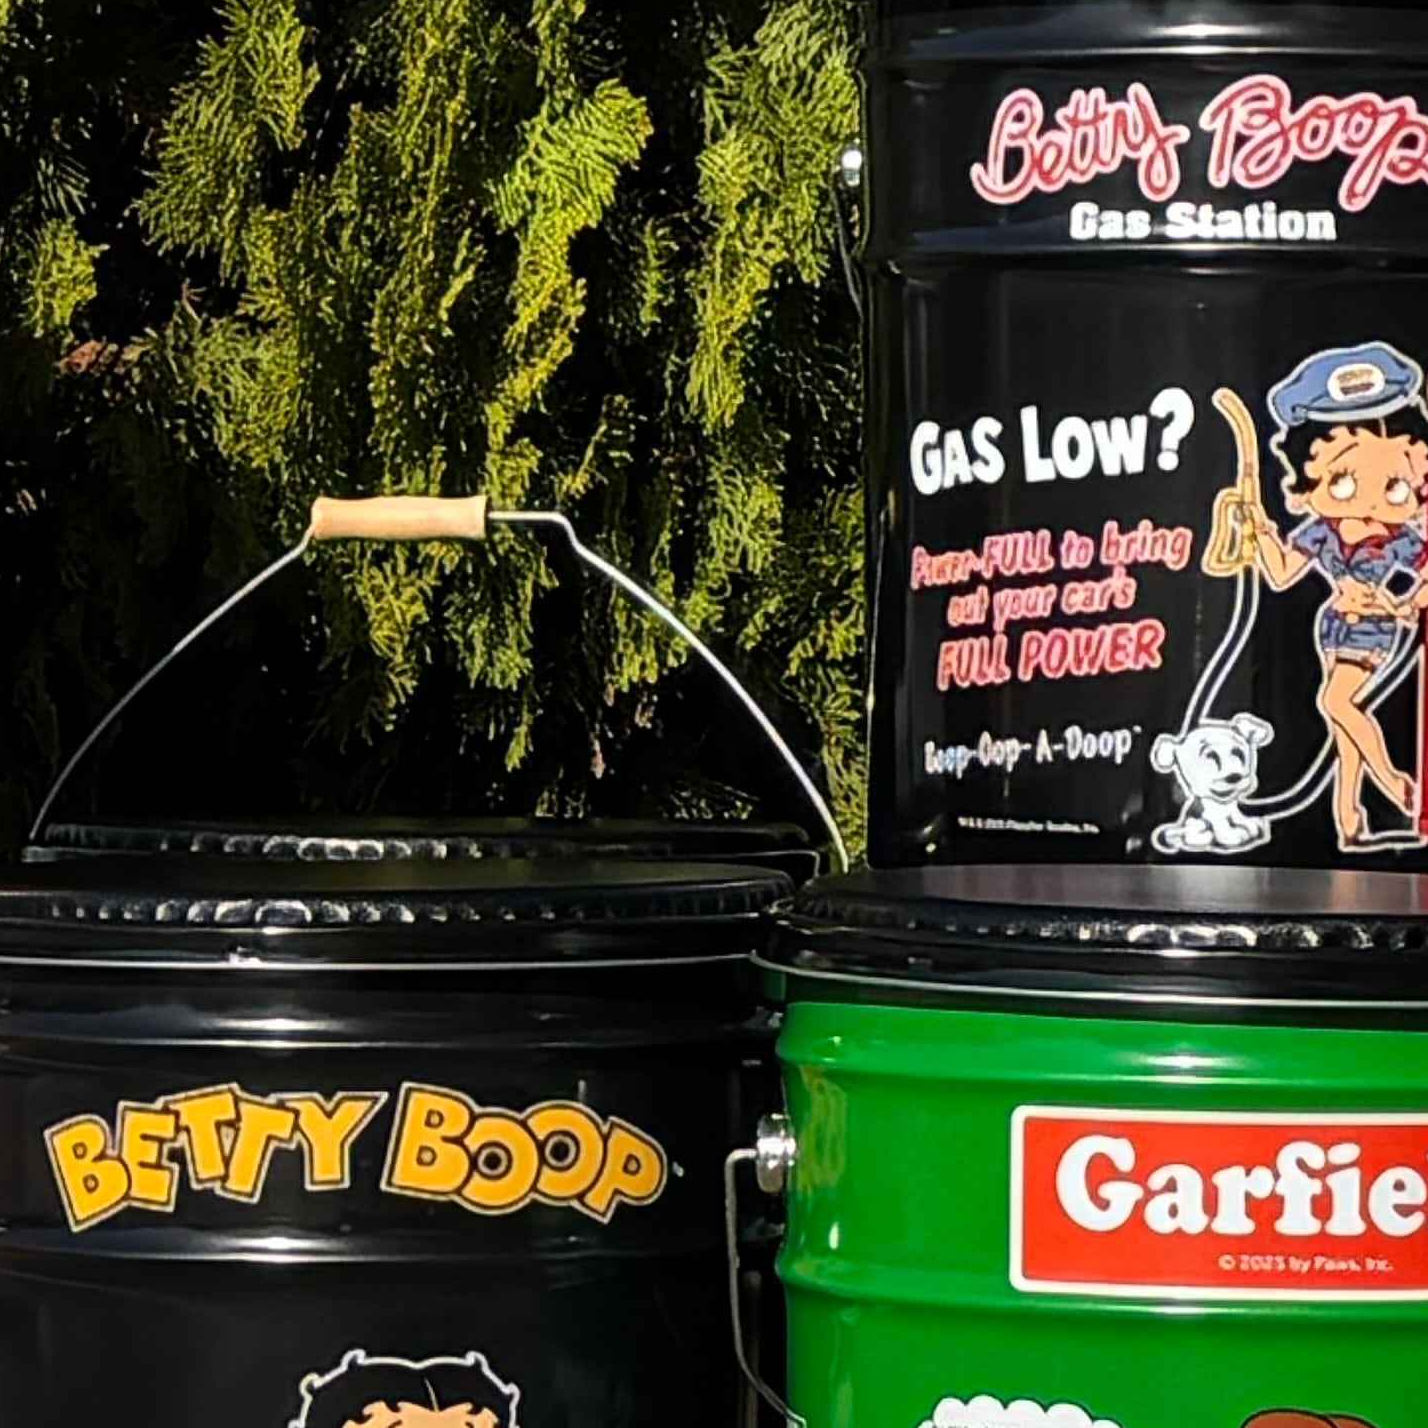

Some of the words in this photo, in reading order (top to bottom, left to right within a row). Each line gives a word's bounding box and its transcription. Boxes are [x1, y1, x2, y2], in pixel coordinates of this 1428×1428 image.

[970, 82, 1190, 203] Betty
[1070, 201, 1152, 241] Gas
[1165, 201, 1337, 241] Station
[1059, 529, 1095, 569] to
[1099, 519, 1193, 570] bring
[947, 585, 990, 627] out
[992, 584, 1058, 633] your
[1061, 565, 1137, 616] car's
[936, 632, 1012, 691] FULL
[1018, 618, 1166, 682] POWER
[43, 1082, 388, 1233] BETTY
[380, 1082, 667, 1225] BOOP
